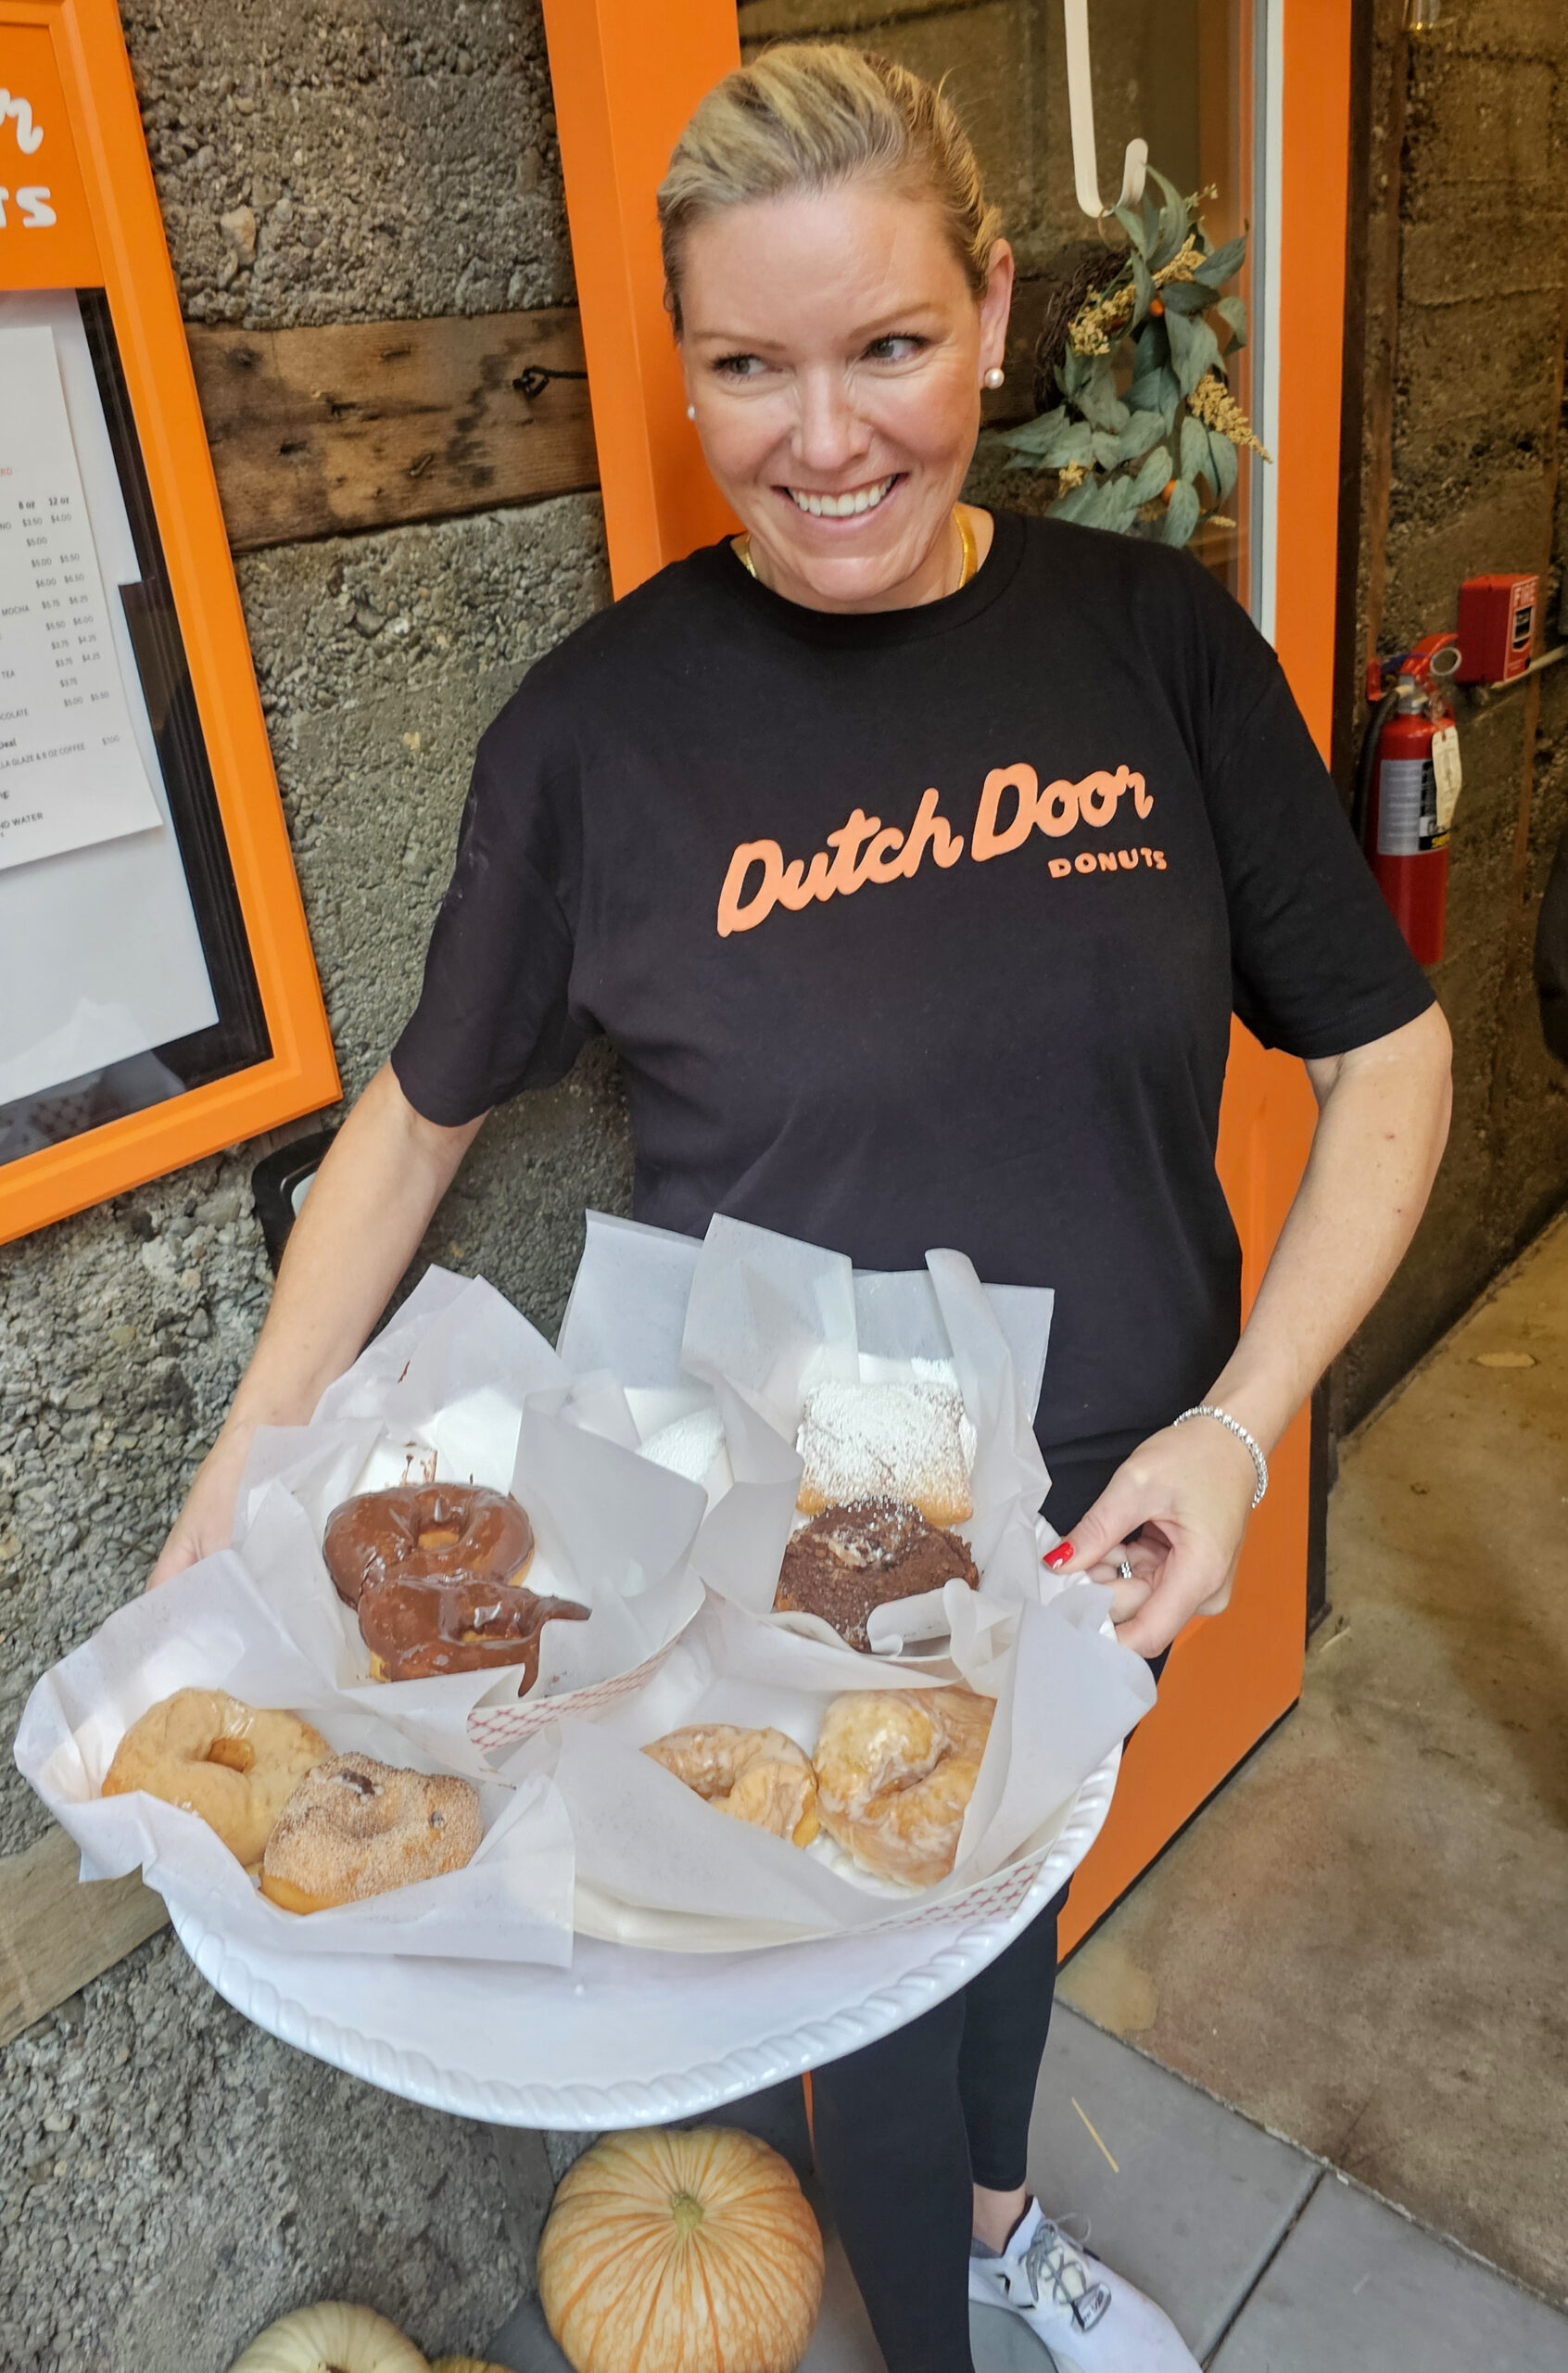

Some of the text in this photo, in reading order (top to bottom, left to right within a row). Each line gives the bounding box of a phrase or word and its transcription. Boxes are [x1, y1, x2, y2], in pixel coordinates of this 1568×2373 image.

[48, 497, 57, 507] 12
[2, 604, 30, 616] MOCHA
[1, 669, 15, 679] TEA
[0, 707, 29, 721] COLATE
[58, 742, 85, 755] COFFEE
[11, 811, 43, 827] WATER
[717, 762, 1154, 937] Dutch Door
[1048, 846, 1168, 880] DONUTS
